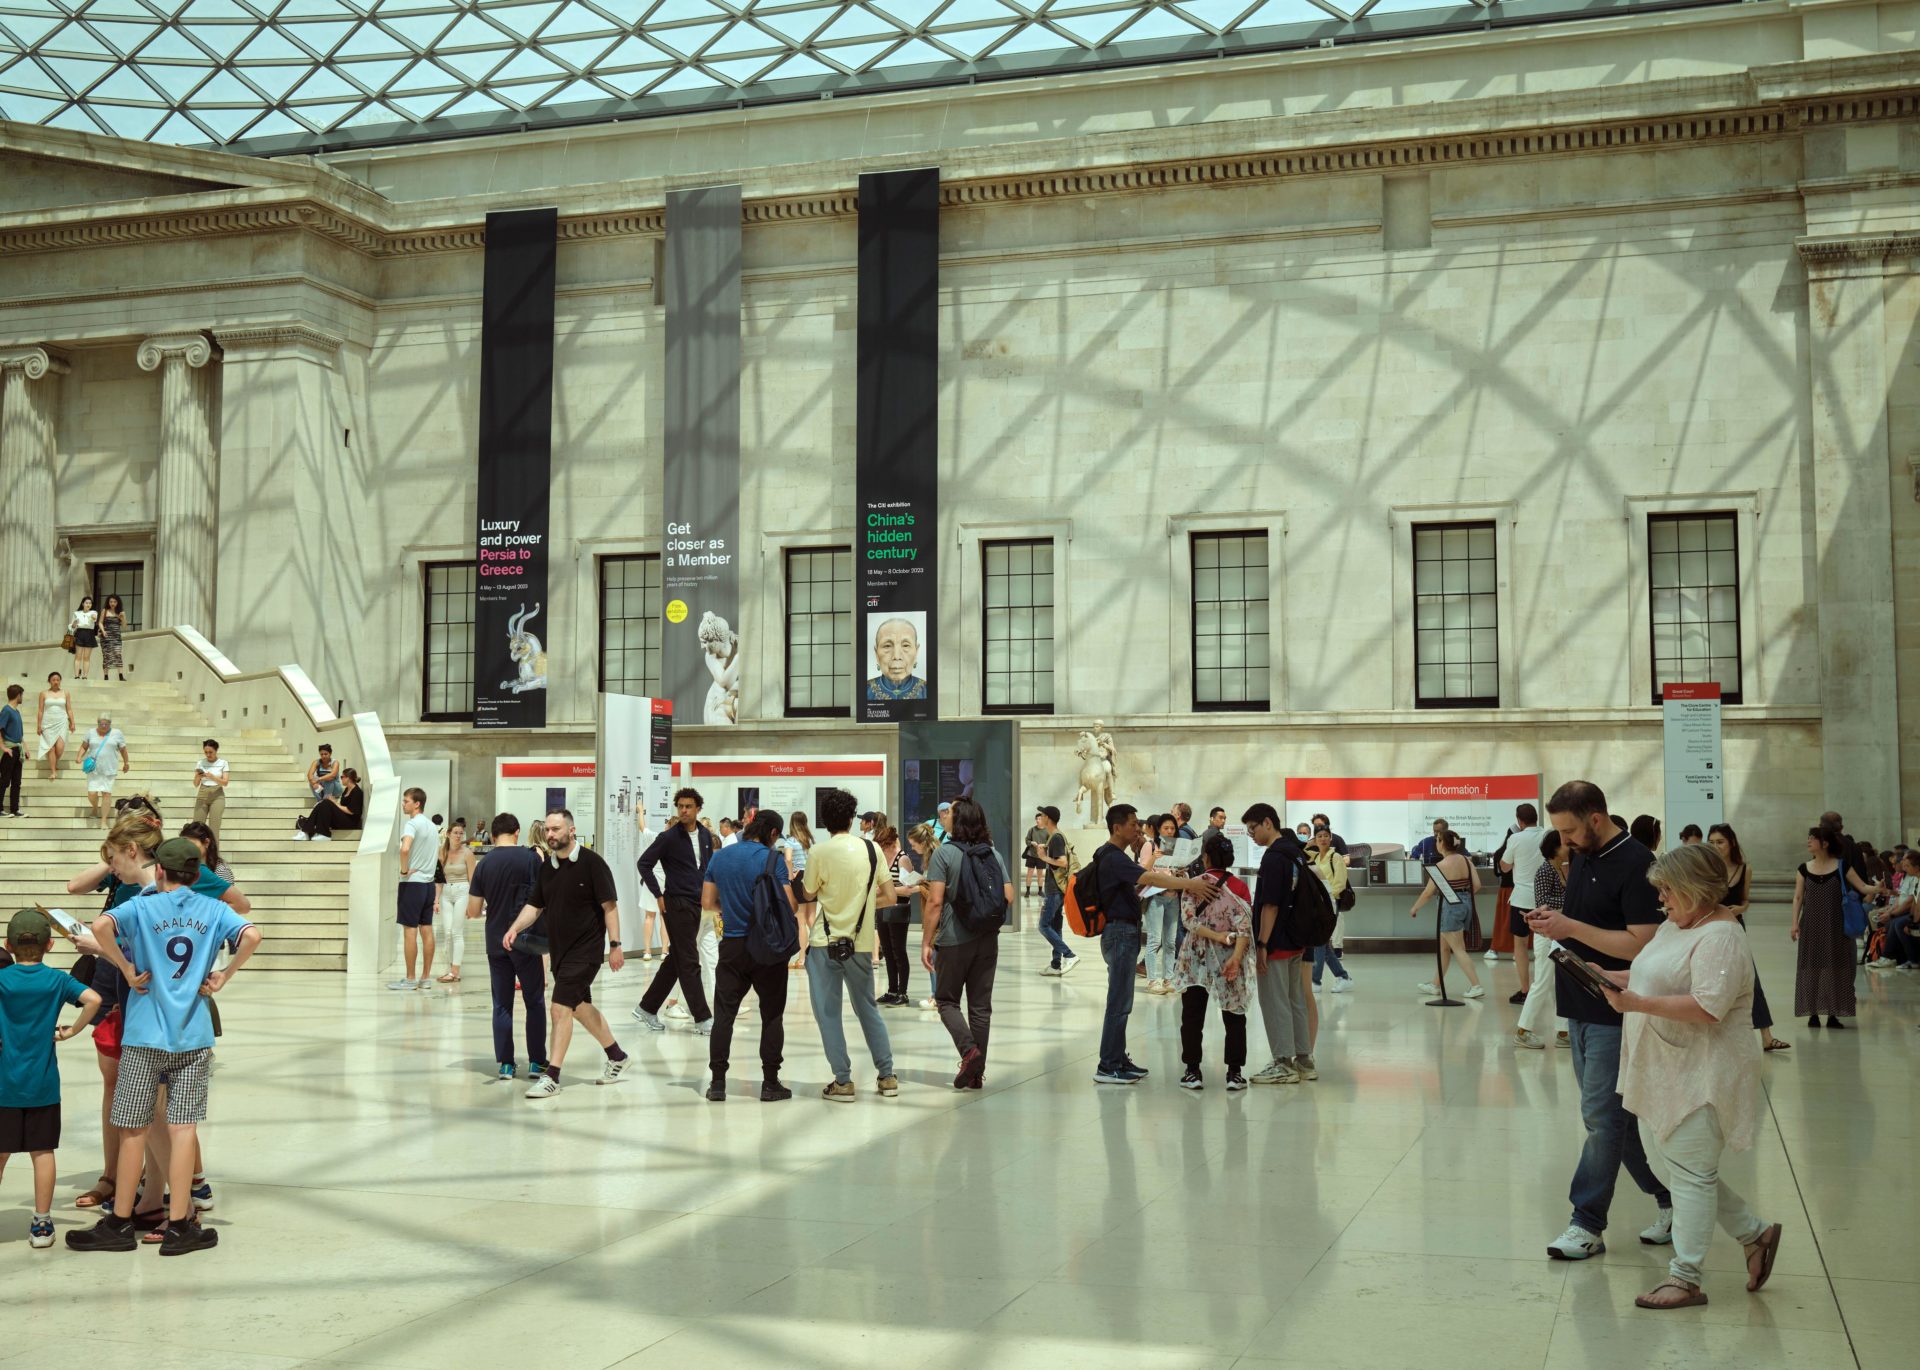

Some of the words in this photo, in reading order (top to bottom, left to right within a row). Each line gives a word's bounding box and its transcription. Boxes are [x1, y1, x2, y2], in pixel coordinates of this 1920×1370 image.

[481, 519, 520, 532] Luxury
[867, 513, 915, 527] China's
[667, 522, 691, 535] Get
[480, 533, 502, 546] and
[505, 534, 542, 547] power
[867, 529, 912, 543] hidden
[667, 538, 705, 550] closer
[709, 539, 725, 549] as
[480, 548, 516, 560] Persia
[519, 548, 531, 559] to
[667, 557, 674, 566] a
[679, 552, 731, 566] Member
[867, 546, 917, 561] century
[480, 564, 523, 576] Greece
[770, 765, 793, 773] Tickets
[1430, 783, 1480, 795] Information
[152, 917, 208, 935] HAALAND
[166, 935, 194, 980] 9
